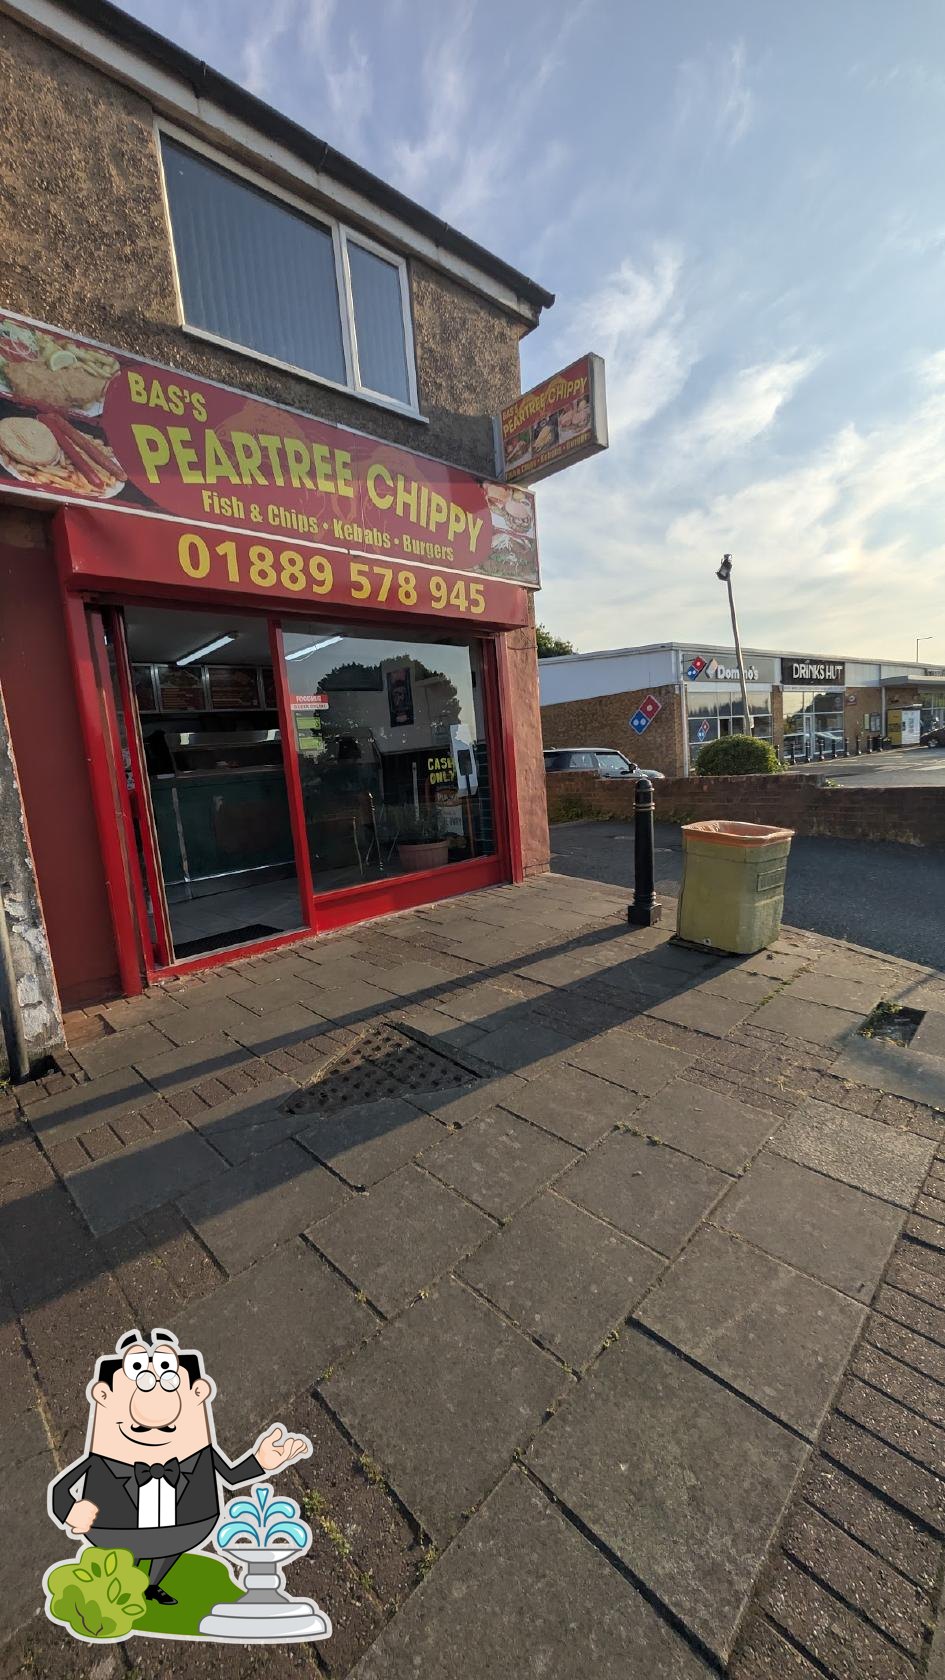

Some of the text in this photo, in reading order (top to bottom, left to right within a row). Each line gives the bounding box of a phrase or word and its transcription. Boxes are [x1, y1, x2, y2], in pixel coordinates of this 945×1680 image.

[128, 371, 208, 423] BAS'S
[503, 377, 588, 436] PEARTREE CHIPPY
[131, 424, 484, 554] PEARTREE CHIPPY
[202, 490, 454, 562] Fish & Chips Kebabs Burgers
[178, 533, 486, 614] 01889 578 945
[717, 664, 759, 681] Domno's
[826, 665, 843, 680] HUT
